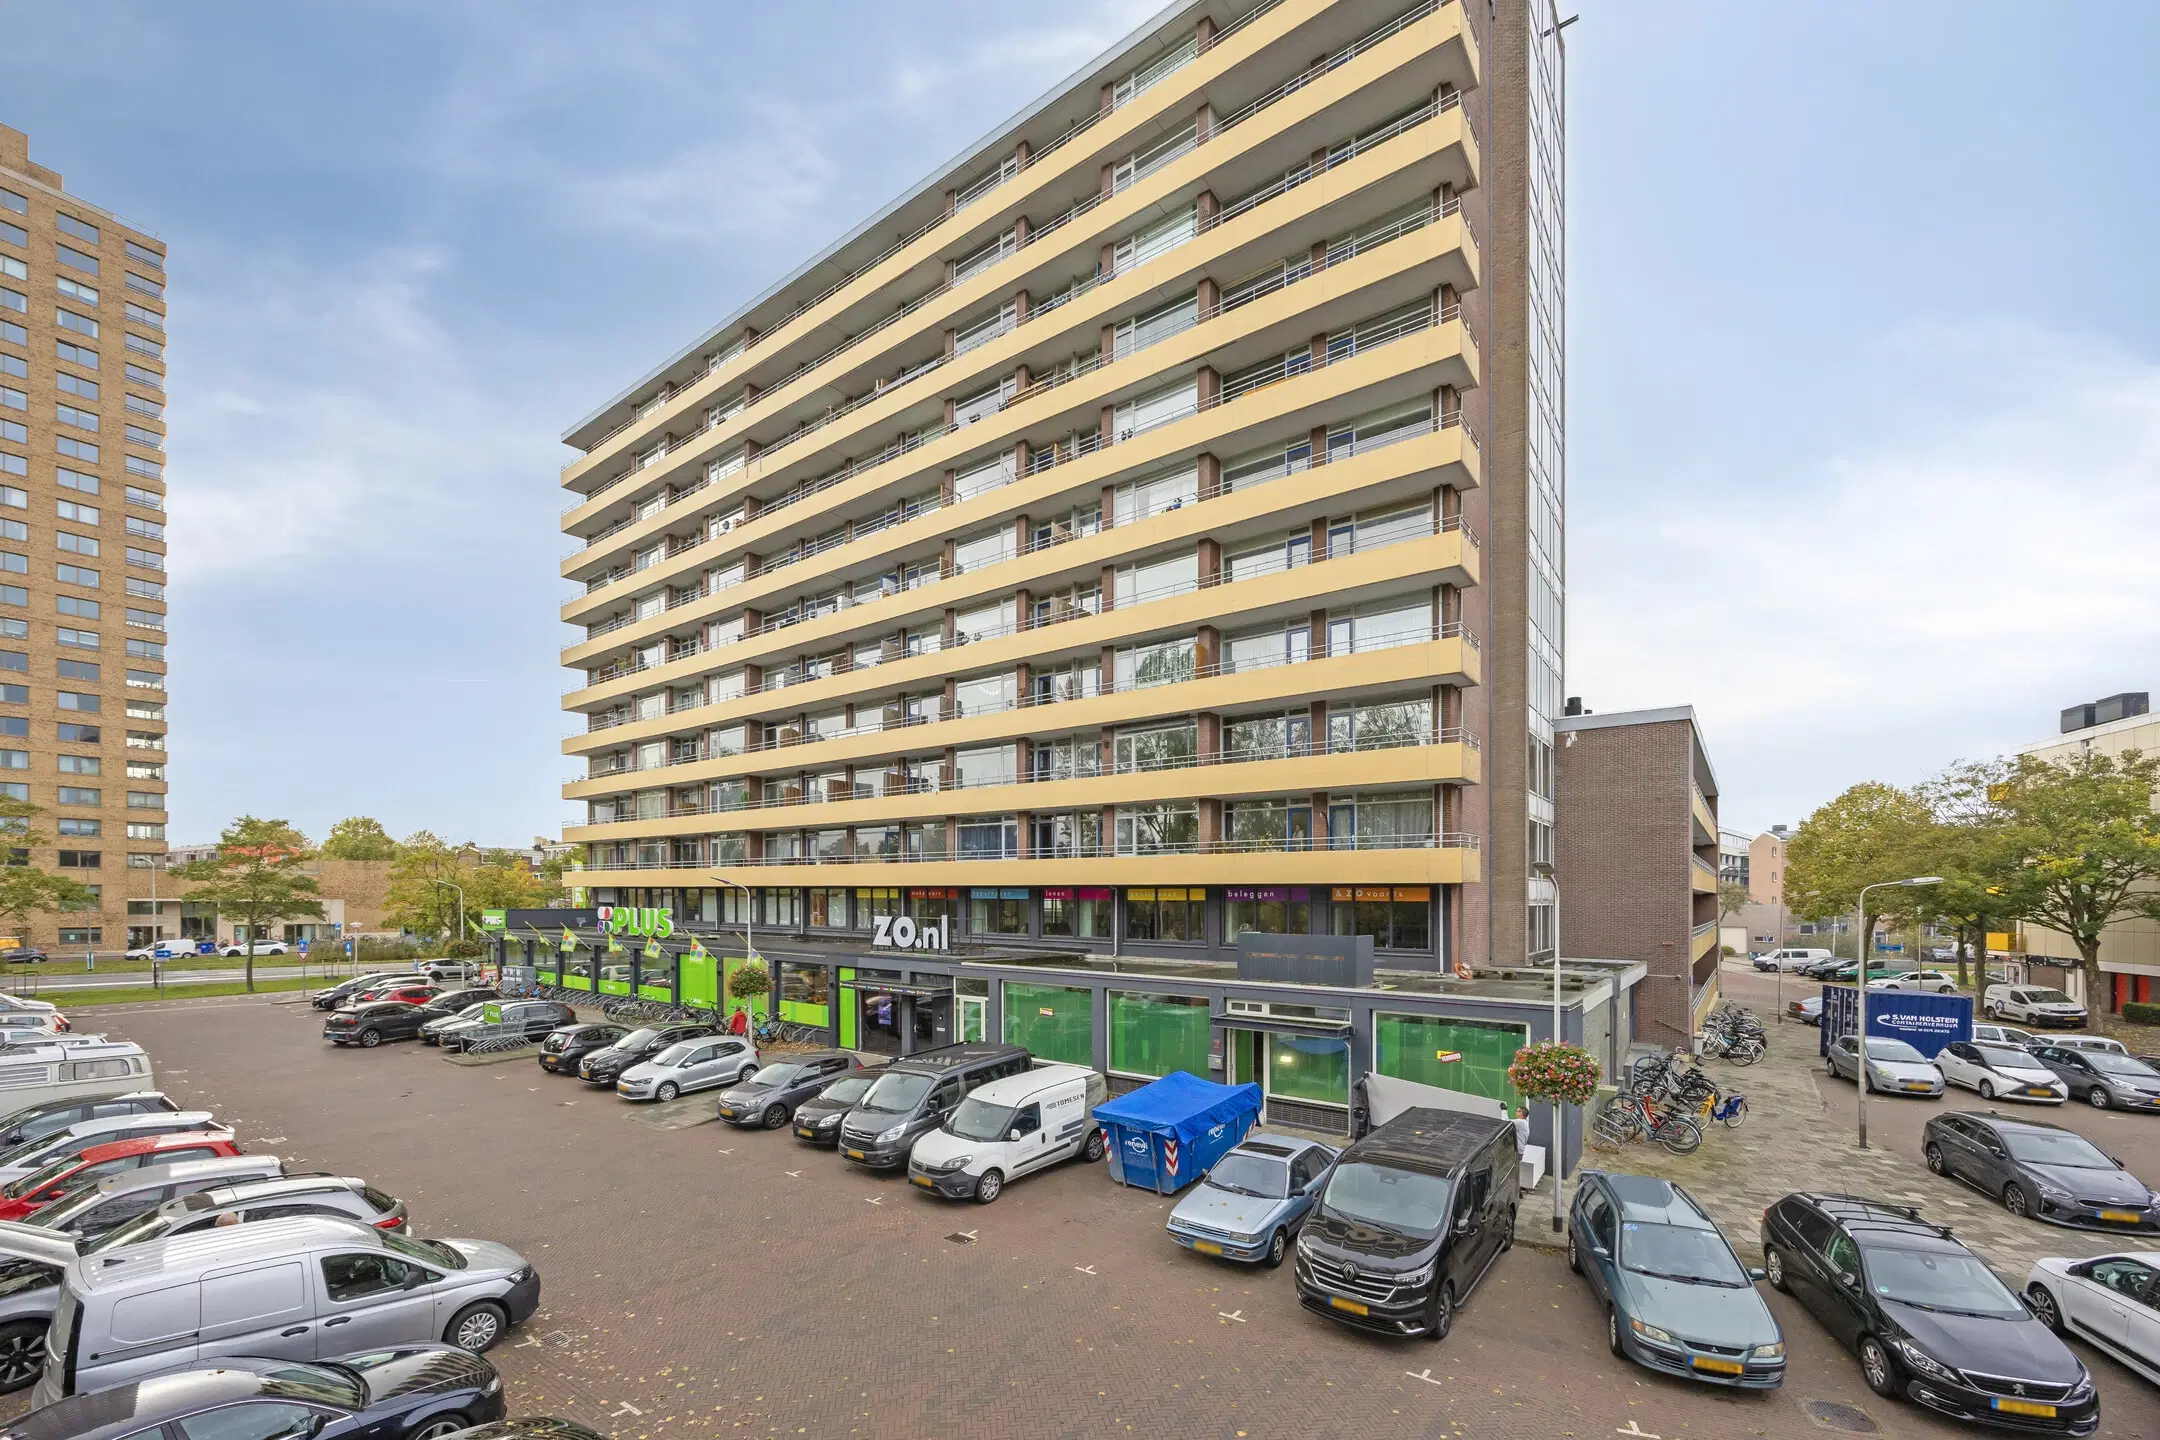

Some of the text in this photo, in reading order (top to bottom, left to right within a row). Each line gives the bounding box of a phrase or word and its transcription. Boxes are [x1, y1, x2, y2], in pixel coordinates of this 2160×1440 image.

[1045, 889, 1065, 897] lenen
[1227, 889, 1275, 899] beleggen
[613, 907, 674, 938] PLUS
[872, 914, 948, 950] ZO.nl
[1057, 1093, 1085, 1107] TOMESEN
[1125, 1139, 1149, 1151] renewi
